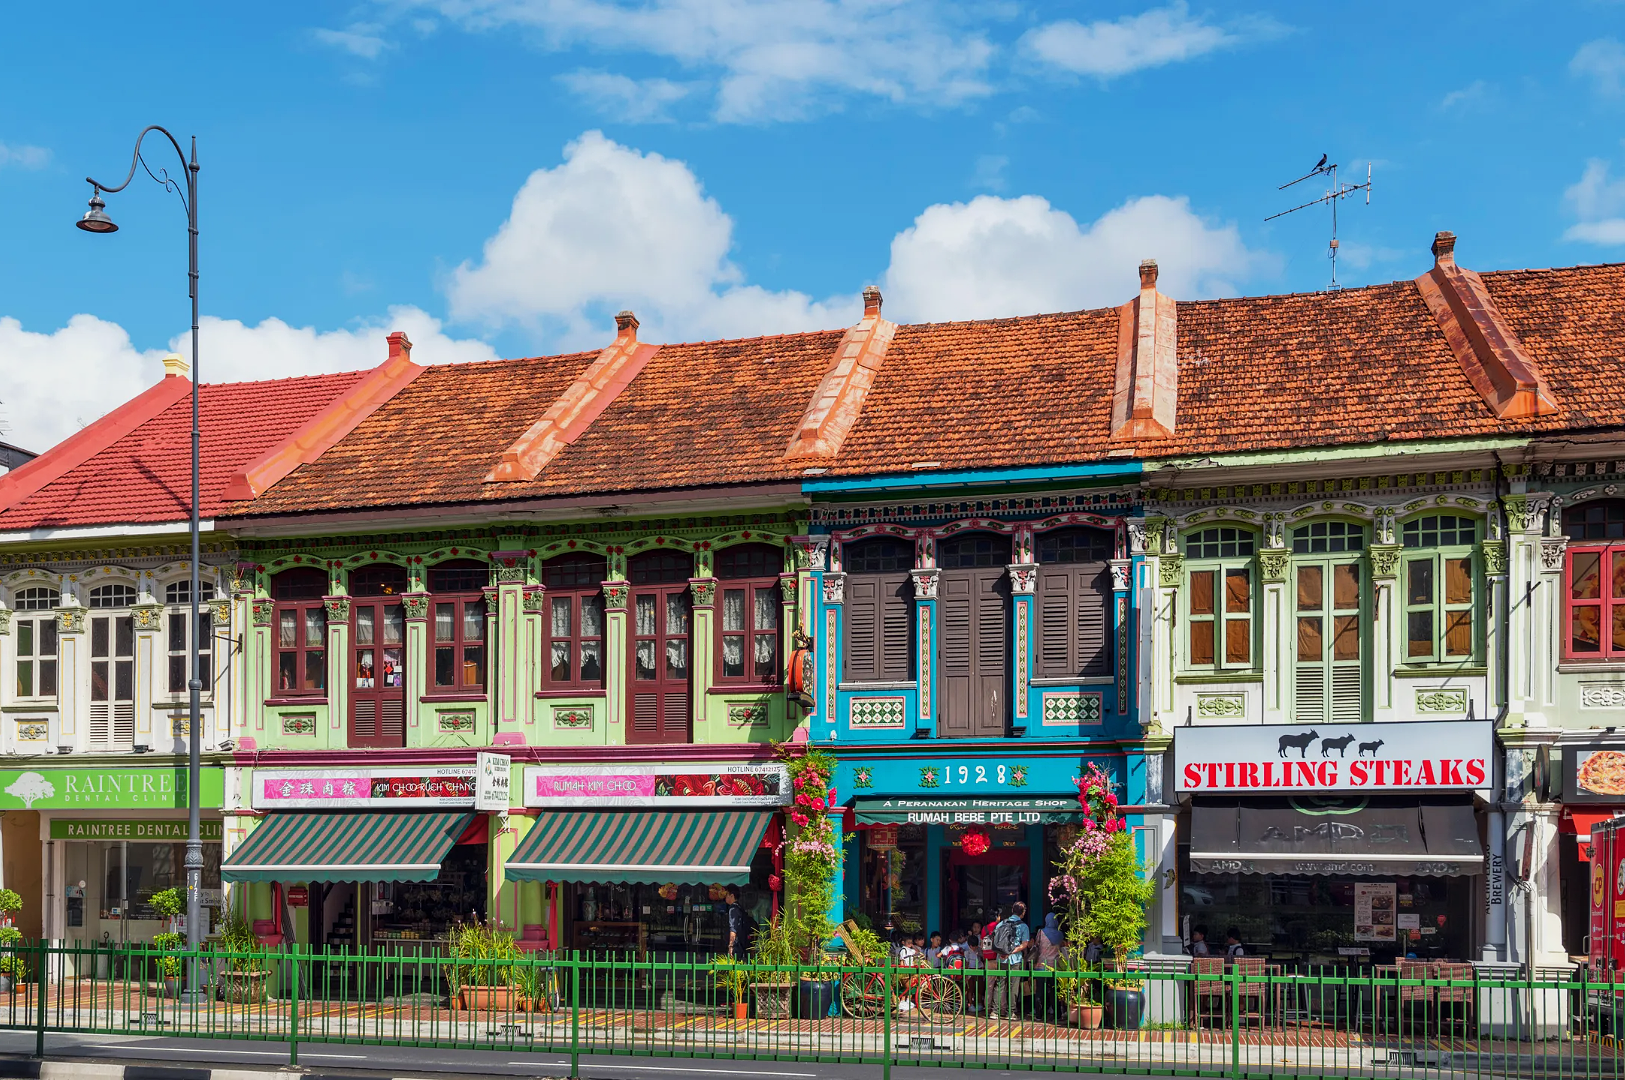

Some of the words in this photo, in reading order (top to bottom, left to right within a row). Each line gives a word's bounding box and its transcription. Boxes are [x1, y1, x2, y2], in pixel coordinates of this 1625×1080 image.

[944, 765, 1006, 784] 1928
[1183, 760, 1339, 788] STIRLING
[1349, 758, 1486, 786] STEAKS
[65, 774, 187, 793] RAINTREE
[376, 783, 389, 792] KIM
[392, 783, 418, 792] CHOO
[420, 782, 443, 792] KUEH
[553, 781, 585, 791] RUMAH
[588, 781, 604, 791] KIM
[607, 780, 637, 791] CHOO
[65, 794, 120, 802] DENTAL
[132, 794, 187, 802] CLINIC
[972, 799, 1030, 807] HERITAGE
[1034, 799, 1067, 807] SHOP
[907, 812, 949, 822] RUMAH
[954, 812, 985, 822] BEBE
[990, 812, 1013, 822] PTE
[1019, 812, 1040, 822] LTD
[68, 824, 131, 836] RAINTREE
[137, 824, 188, 836] DENTAL
[1211, 860, 1242, 871] AMD
[1491, 853, 1502, 905] BREWERY
